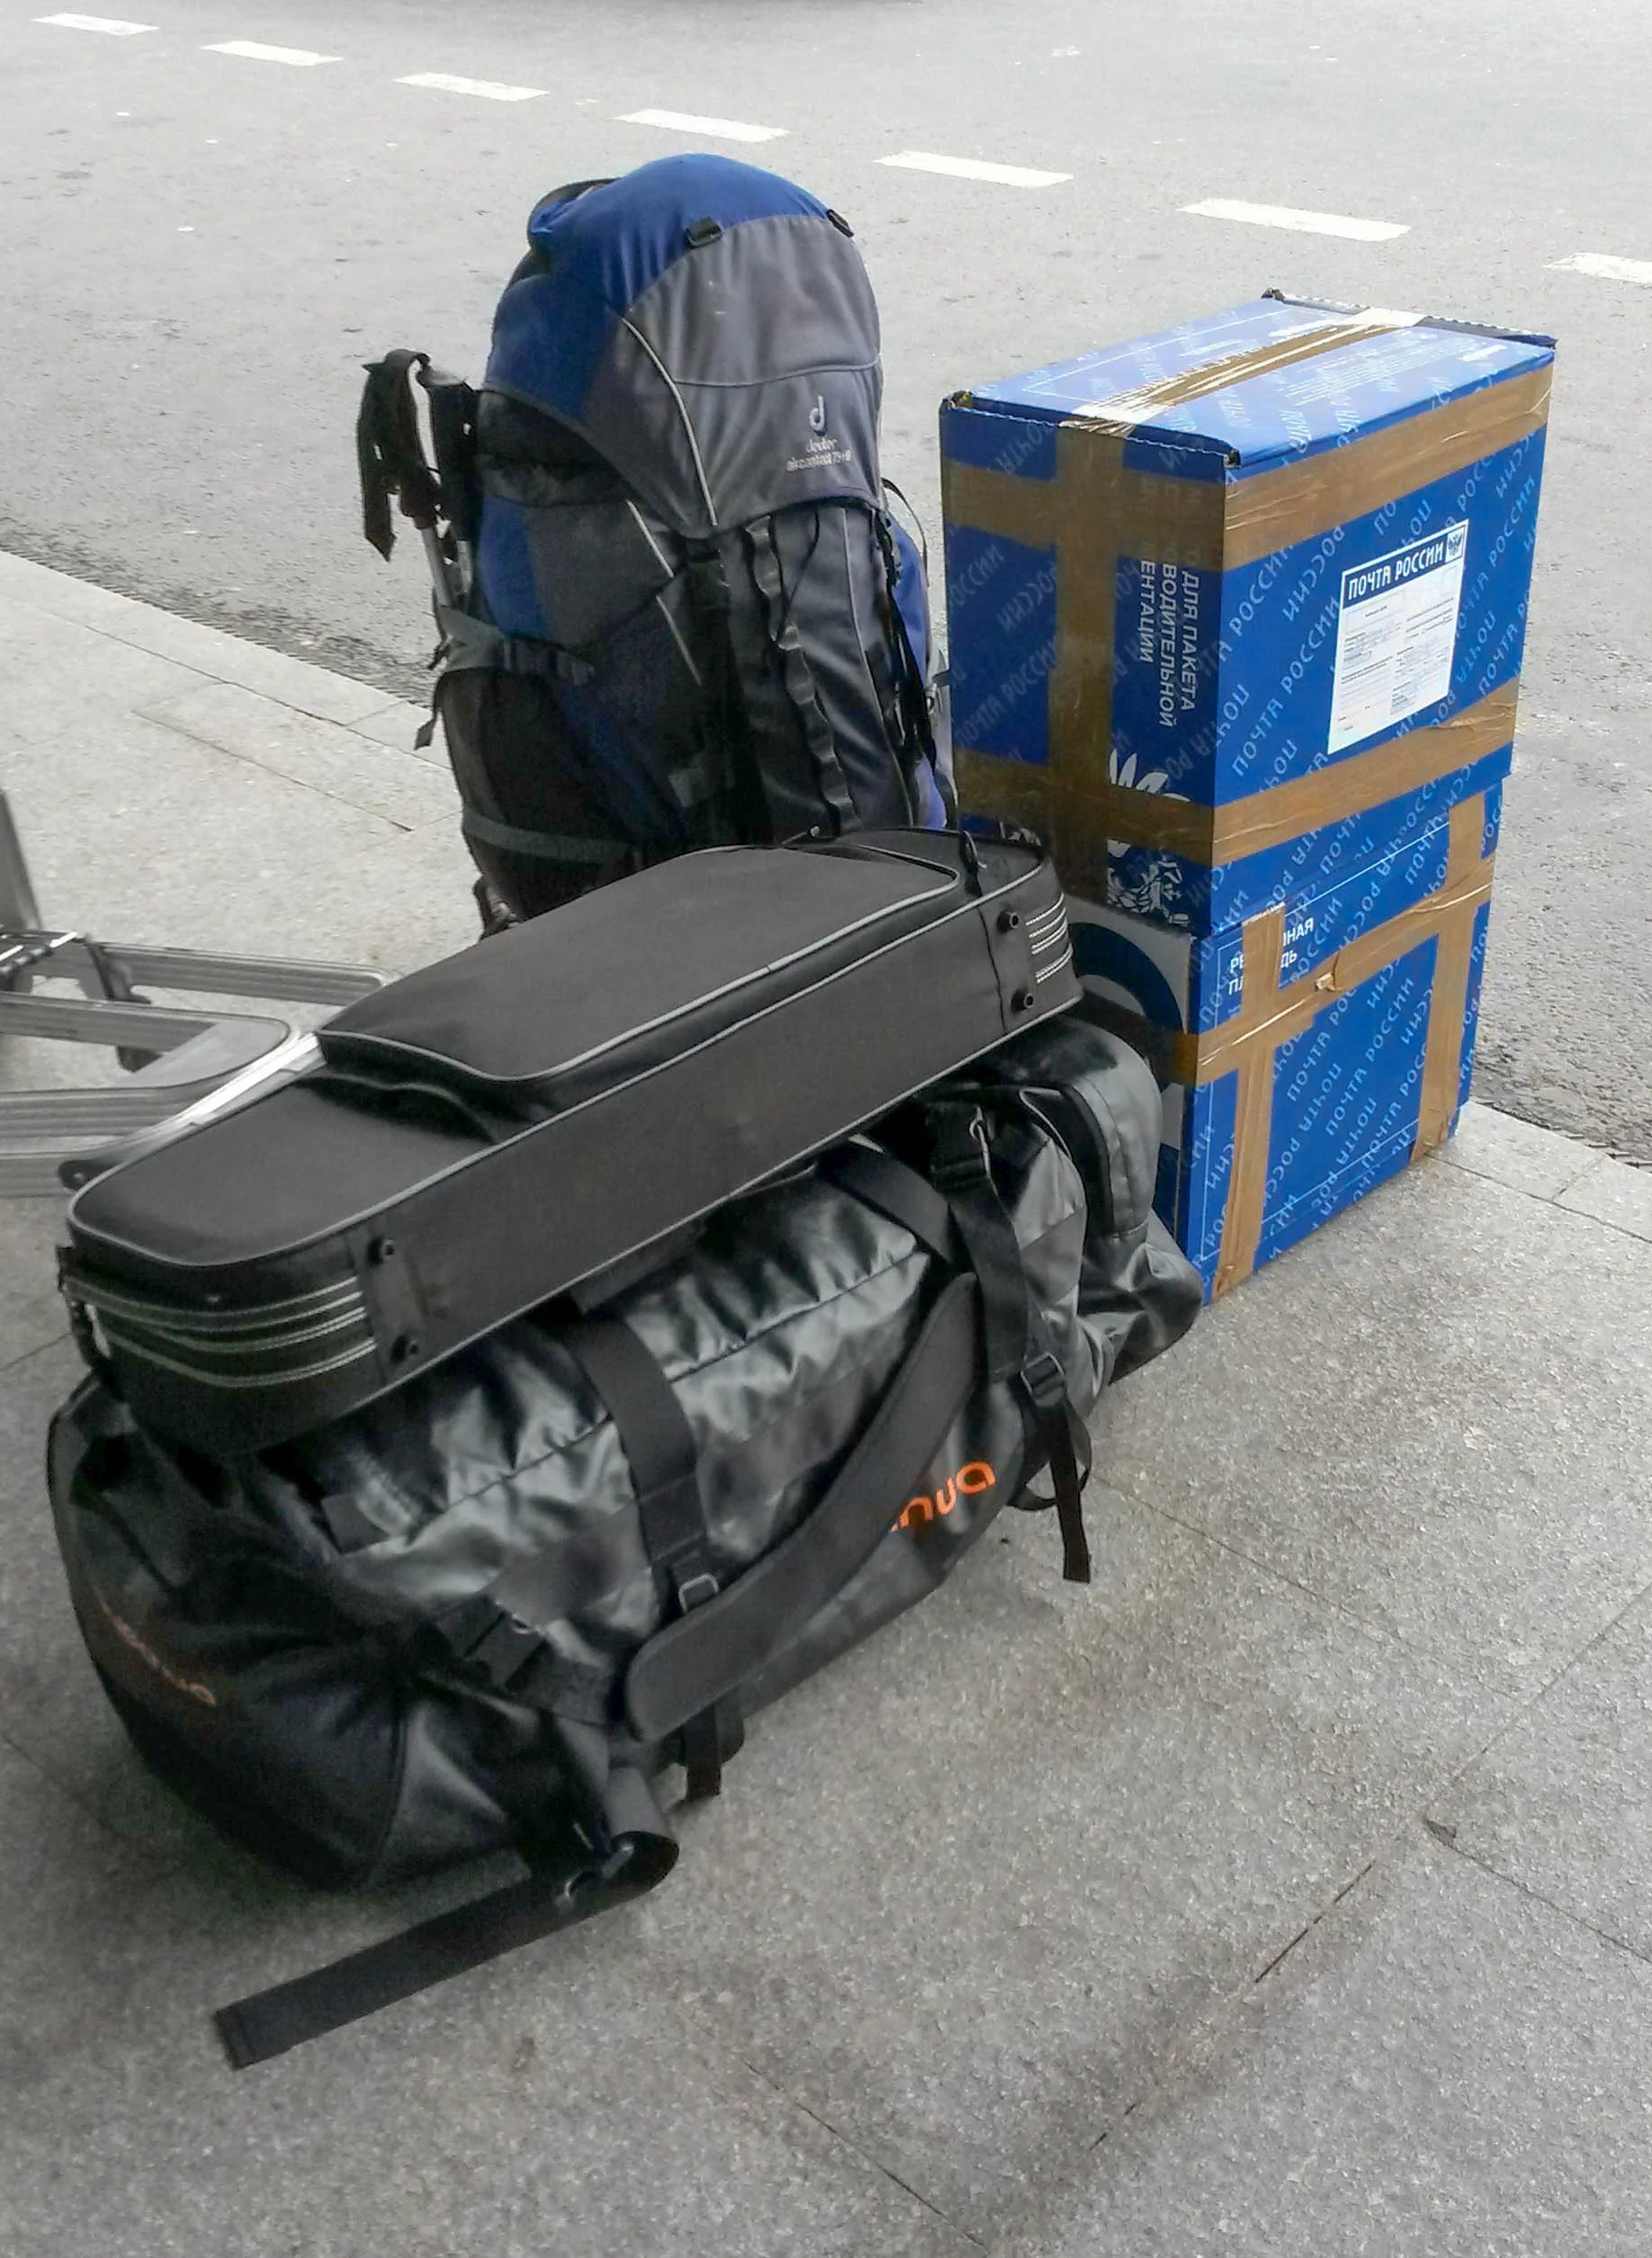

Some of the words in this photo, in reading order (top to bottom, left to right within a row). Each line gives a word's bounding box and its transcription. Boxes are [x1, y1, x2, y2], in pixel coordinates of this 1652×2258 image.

[1181, 570, 1199, 620] ДЛЯ
[1349, 565, 1392, 600] ПОЧТА
[1395, 541, 1444, 581] РОССИИ
[1180, 624, 1198, 710] ПАКЕТА
[1455, 611, 1496, 684] ПОЧТА
[1478, 623, 1519, 696] ПОЧТА
[1232, 698, 1283, 777] ПОЧТА
[1287, 1031, 1332, 1102] ПОЧТА
[1325, 1067, 1368, 1136] ПОЧТА
[1365, 976, 1415, 1062] РОССИИ
[1298, 1062, 1342, 1132] ПОЧТА
[1335, 1097, 1378, 1165] ПОЧТА
